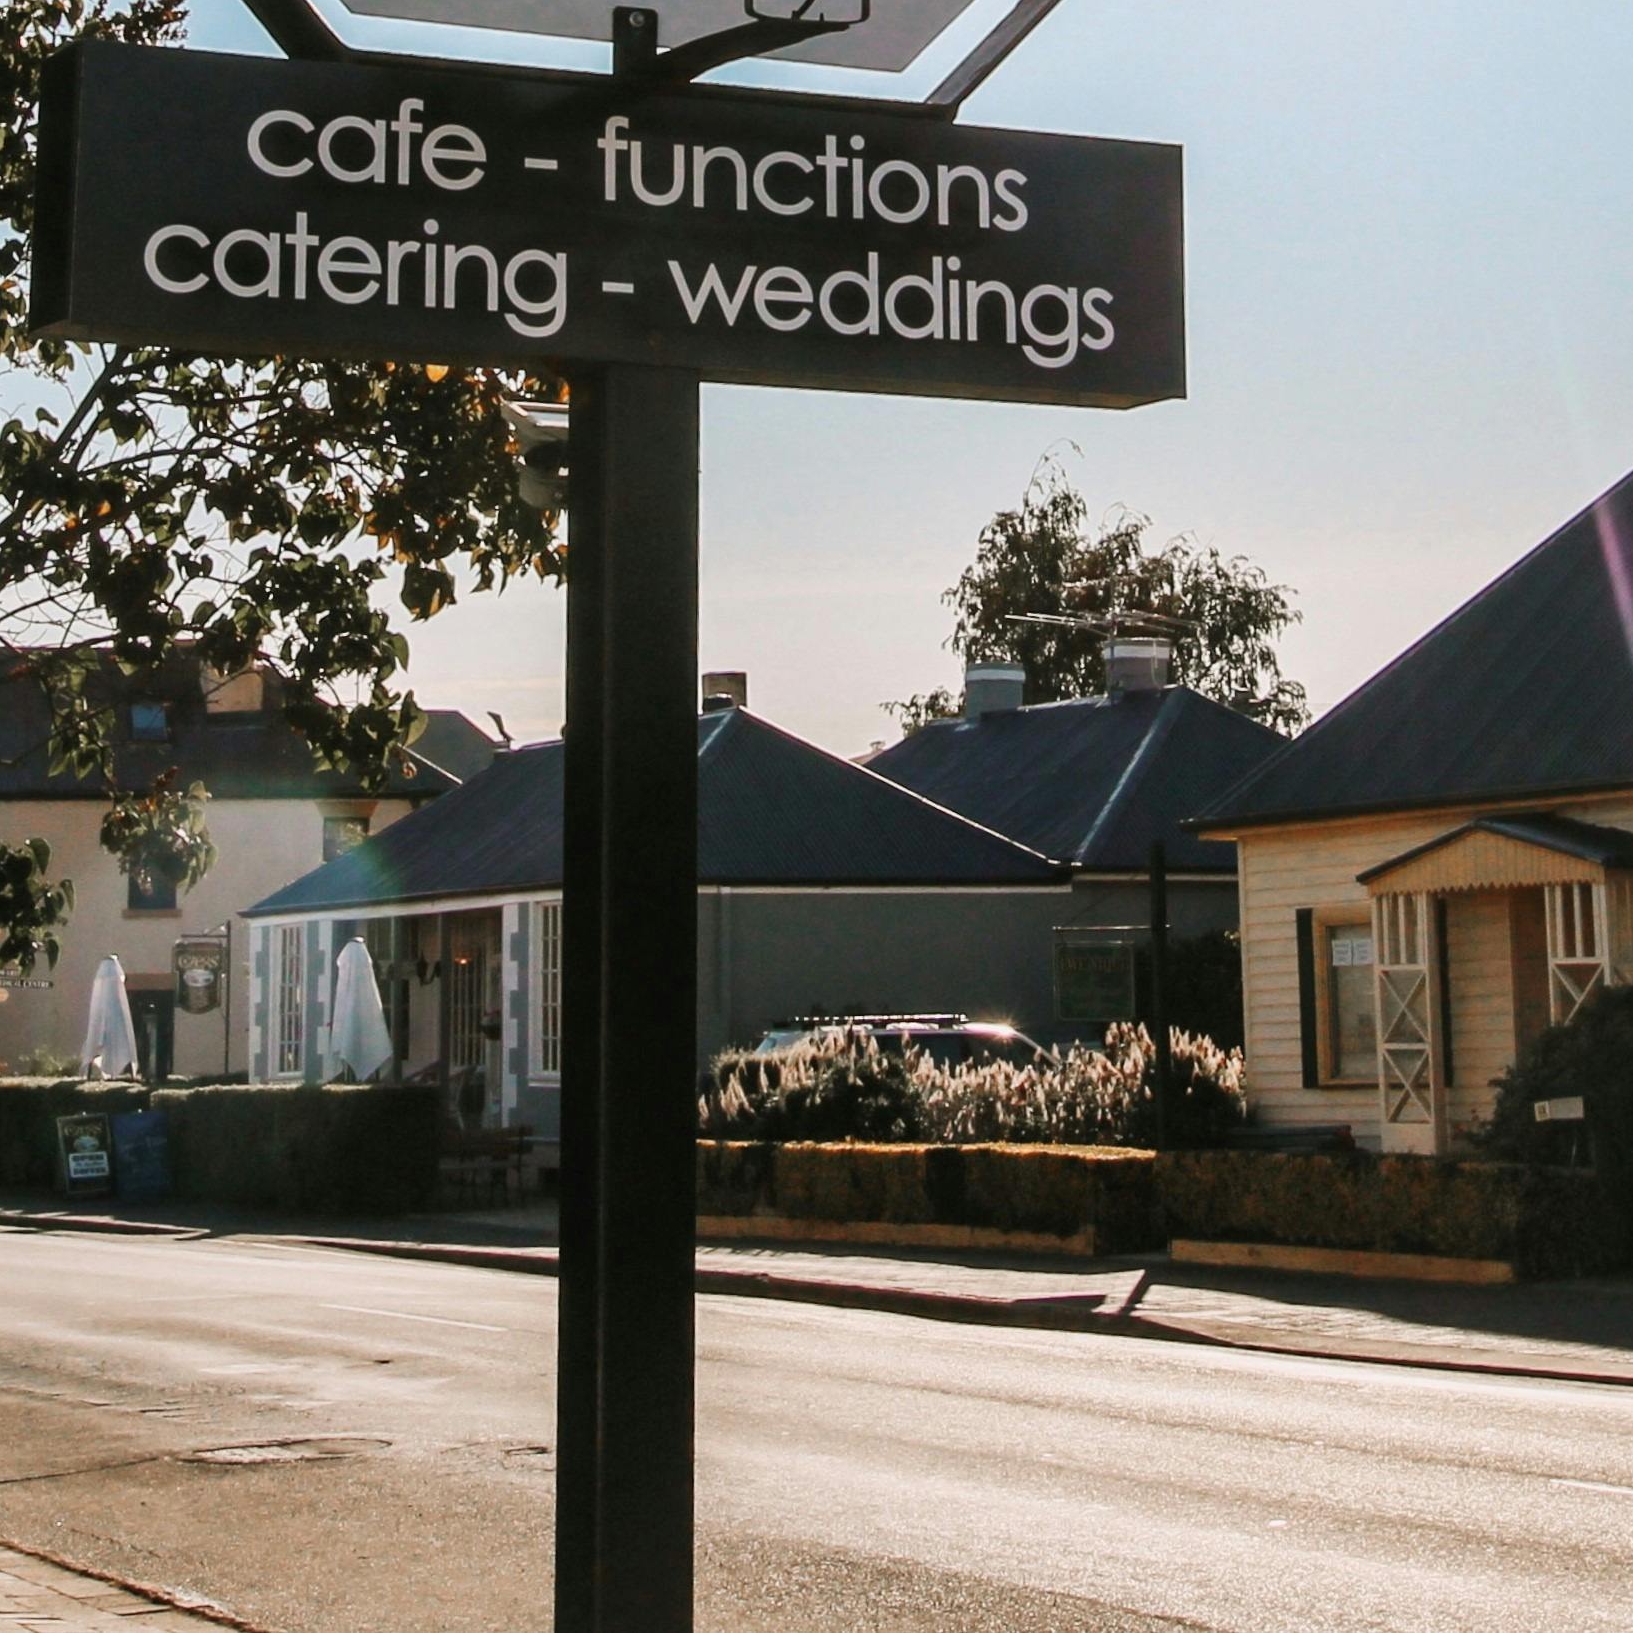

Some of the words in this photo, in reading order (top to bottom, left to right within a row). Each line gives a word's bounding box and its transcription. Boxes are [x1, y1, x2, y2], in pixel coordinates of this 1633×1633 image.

[246, 97, 487, 191] cafe
[597, 115, 1029, 232] functions
[143, 211, 567, 338] catering
[667, 251, 1115, 370] weddings
